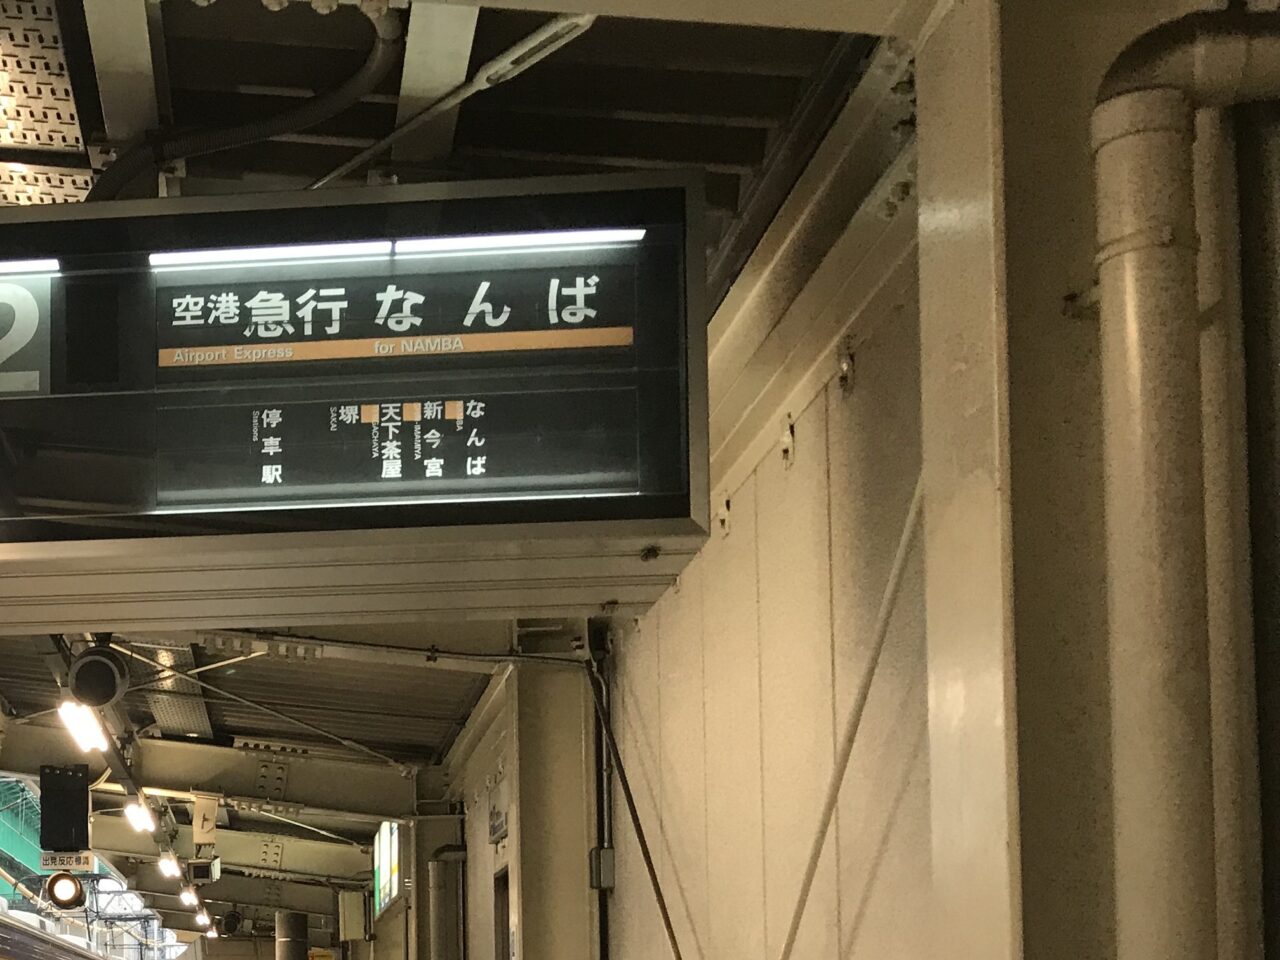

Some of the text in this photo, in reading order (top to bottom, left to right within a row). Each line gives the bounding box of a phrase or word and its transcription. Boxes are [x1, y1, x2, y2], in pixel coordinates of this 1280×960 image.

[172, 274, 601, 338] 空港急行 なんば
[173, 337, 464, 365] Airport Express for NAMBA
[261, 408, 283, 484] 停車駅
[330, 406, 338, 432] SAKAI
[338, 405, 360, 425] 堺
[380, 403, 403, 479] 天下茶屋
[423, 400, 445, 478] 新今宮
[465, 399, 487, 476] なんば
